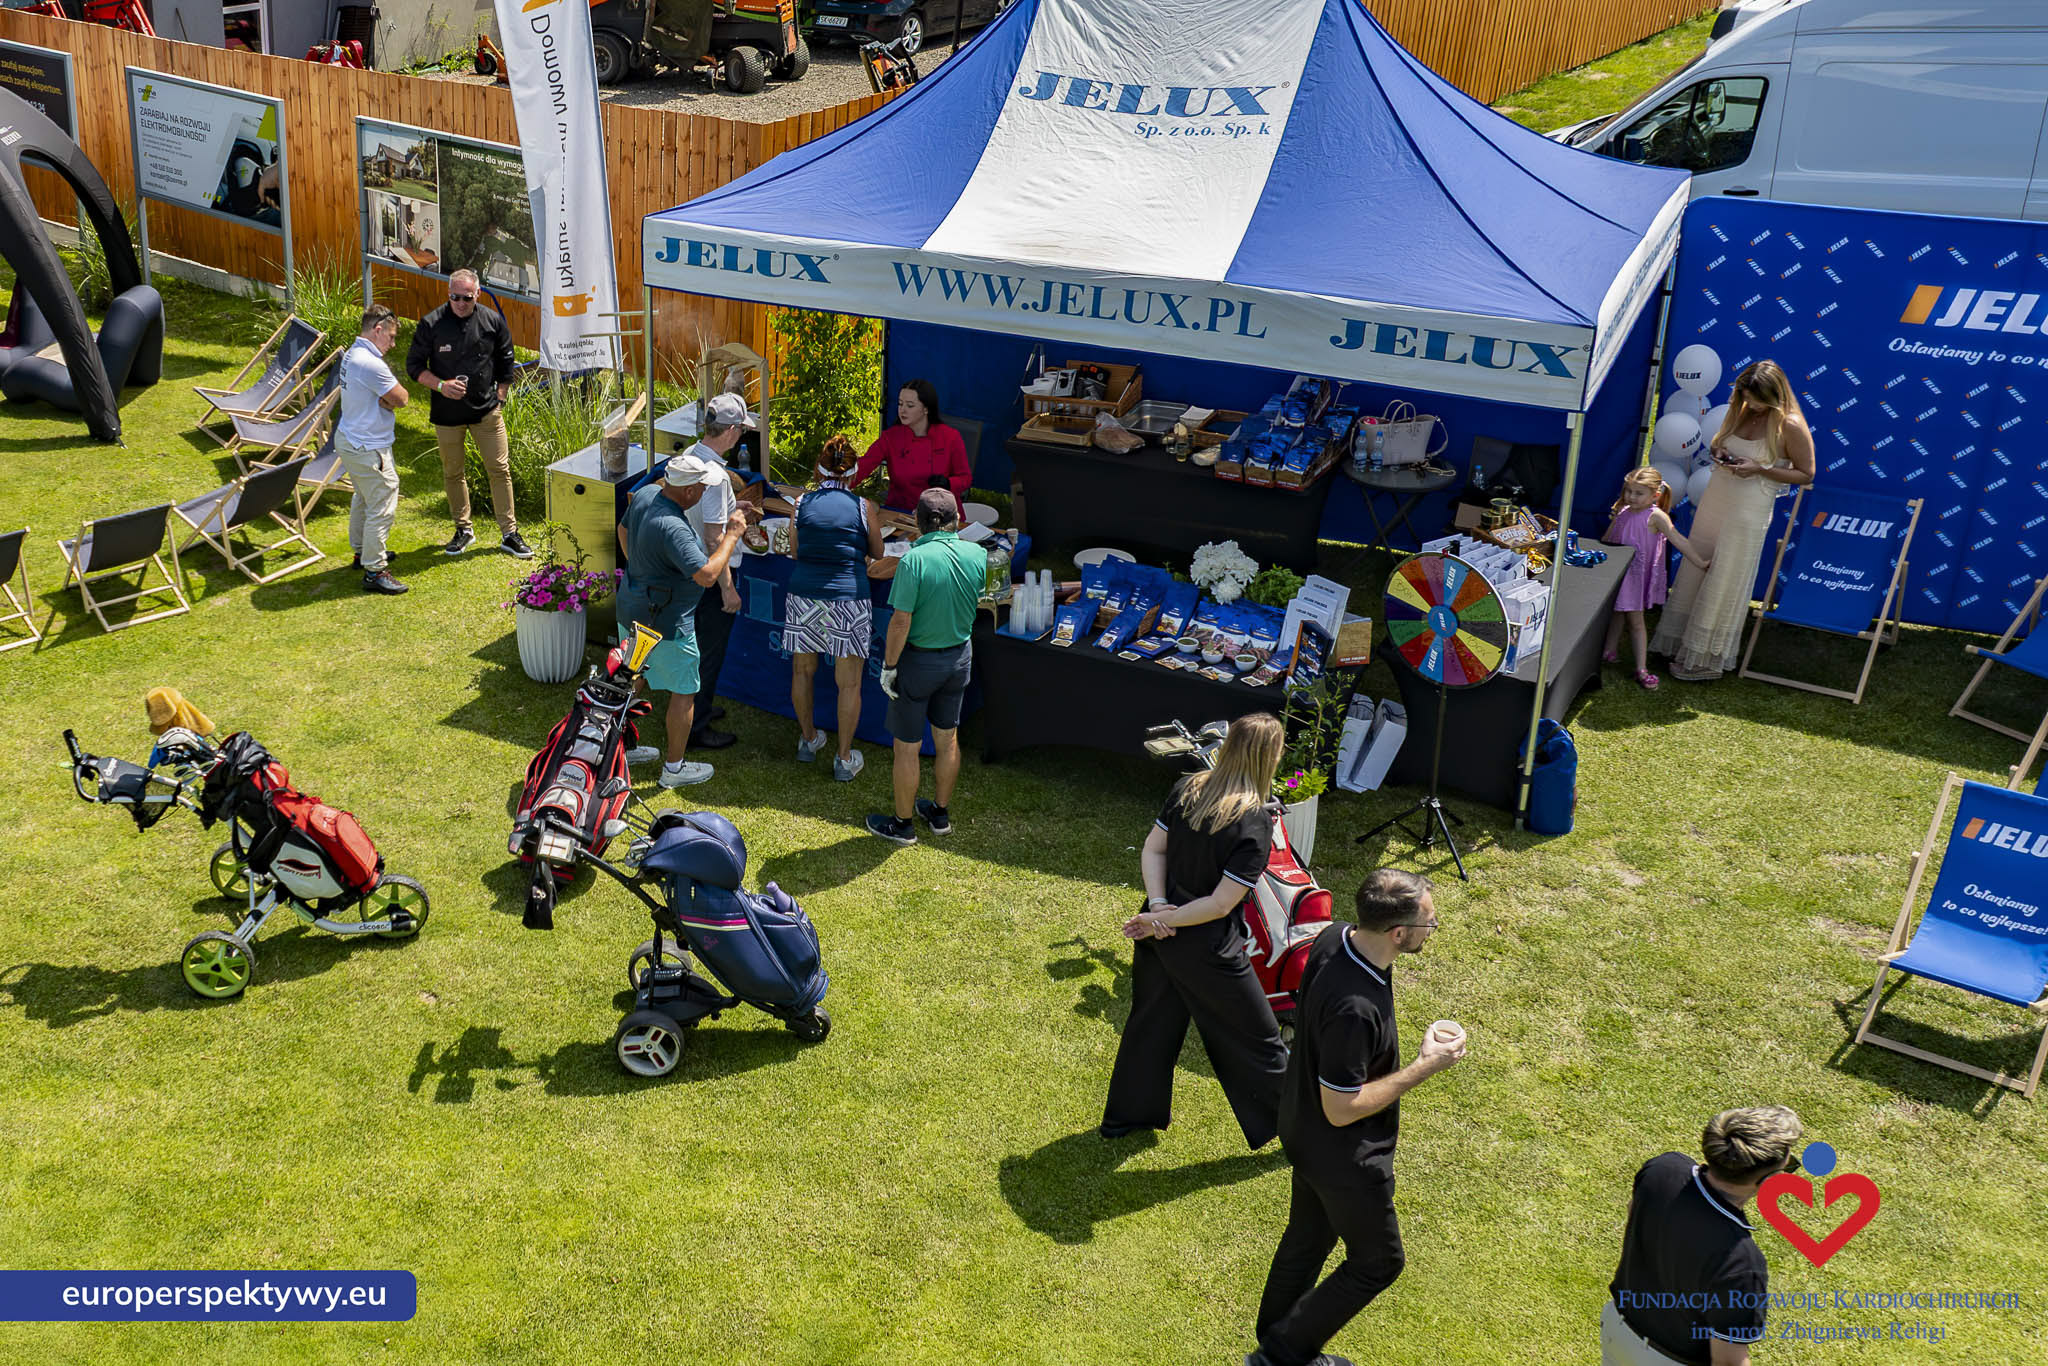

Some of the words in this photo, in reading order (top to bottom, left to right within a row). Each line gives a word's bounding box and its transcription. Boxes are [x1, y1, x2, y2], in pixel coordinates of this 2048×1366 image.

[139, 106, 169, 122] ZARABIAJ
[170, 114, 180, 124] NA
[180, 116, 211, 132] ROZWOJU
[1134, 121, 1163, 139] Sp.
[1169, 125, 1180, 137] z
[1184, 125, 1215, 137] o.o.
[1222, 122, 1251, 139] Sp.
[1258, 122, 1271, 135] k
[451, 147, 485, 163] Intymność
[485, 154, 497, 165] dla
[1710, 225, 1729, 242] JELUX
[1751, 230, 1771, 245] JELUX
[1786, 232, 1805, 250] JELUX
[1829, 237, 1849, 253] JELUX
[1866, 240, 1885, 258] JELUX
[1909, 244, 1931, 260] JELUX
[1708, 255, 1726, 271] JELUX
[1948, 247, 1968, 265] JELUX
[1998, 251, 2018, 267] JELUX
[1748, 259, 1765, 276] JELUX
[1782, 262, 1802, 278] JELUX
[1825, 266, 1843, 284] JELUX
[891, 262, 1268, 340] WWW.JELUX.PL
[1703, 289, 1720, 305] JELUX
[1742, 294, 1762, 309] JELUX
[1777, 297, 1795, 314] JELUX
[1817, 302, 1838, 316] JELUX
[1701, 318, 1717, 332] JELUX
[1739, 322, 1756, 338] JELUX
[1774, 326, 1791, 340] JELUX
[1815, 330, 1832, 347] JELUX
[1735, 356, 1752, 369] JELUX
[1987, 351, 2007, 362] to
[2011, 355, 2034, 365] co
[1679, 372, 1701, 380] JELUX
[1810, 365, 1827, 378] JELUX
[1844, 371, 1861, 385] JELUX
[1888, 374, 1906, 388] JELUX
[1924, 380, 1942, 394] JELUX
[1968, 383, 1989, 397] JELUX
[2008, 386, 2027, 403] JELUX
[1804, 393, 1821, 408] JELUX
[1837, 397, 1858, 412] JELUX
[1882, 402, 1899, 418] JELUX
[1919, 407, 1938, 420] JELUX
[1962, 413, 1981, 428] JELUX
[1999, 416, 2022, 430] JELUX
[1833, 432, 1849, 445] JELUX
[1873, 436, 1894, 448] JELUX
[1912, 441, 1928, 455] JELUX
[1955, 445, 1975, 459] JELUX
[1829, 458, 1846, 470] JELUX
[1994, 449, 2012, 465] JELUX
[1870, 464, 1887, 478] JELUX
[1906, 468, 1925, 480] JELUX
[1949, 472, 1967, 488] JELUX
[1988, 478, 2007, 491] JELUX
[1824, 514, 1894, 539] JELUX
[1446, 566, 1457, 589] JELUX
[1798, 572, 1809, 580] to
[1823, 580, 1874, 592] najlepsze!
[1427, 649, 1438, 672] JELUX
[1979, 822, 2048, 858] JELU
[1942, 900, 1957, 910] to
[1959, 907, 1977, 917] co
[1978, 913, 2048, 936] najlepsze!
